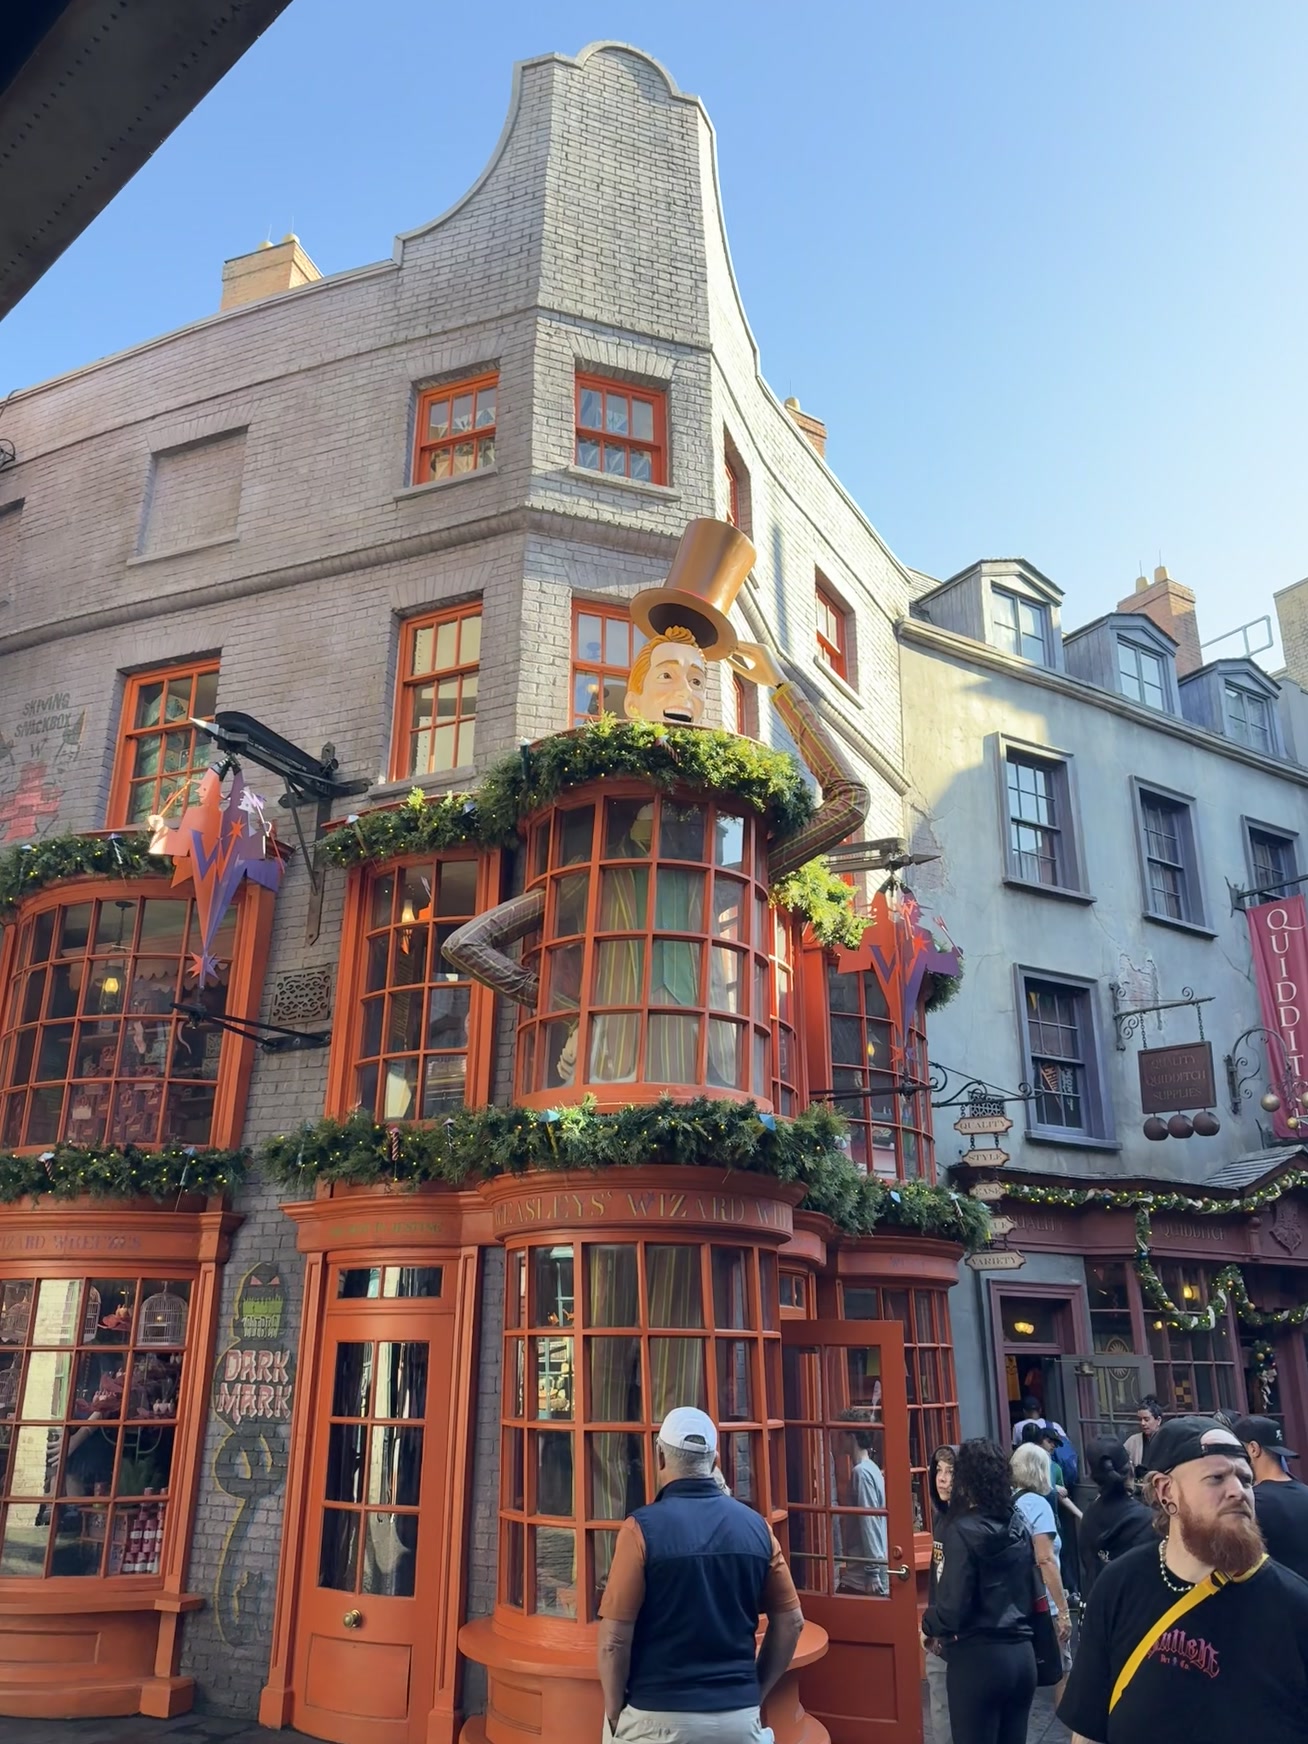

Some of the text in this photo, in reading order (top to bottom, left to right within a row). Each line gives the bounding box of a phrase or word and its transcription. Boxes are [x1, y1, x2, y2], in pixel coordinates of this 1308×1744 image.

[22, 692, 71, 717] SKIVING
[1151, 1054, 1196, 1069] QUALITY
[1146, 1070, 1206, 1086] QUIDDITCH
[1153, 1088, 1201, 1101] SUPPLIES
[959, 1119, 1006, 1131] QUALITY
[968, 1152, 1003, 1163] STYLE
[974, 1186, 1001, 1196] EASE
[627, 1190, 745, 1223] WIZARD
[971, 1257, 1018, 1267] VARIETY
[224, 1349, 291, 1385] DARK
[215, 1382, 293, 1426] MARK
